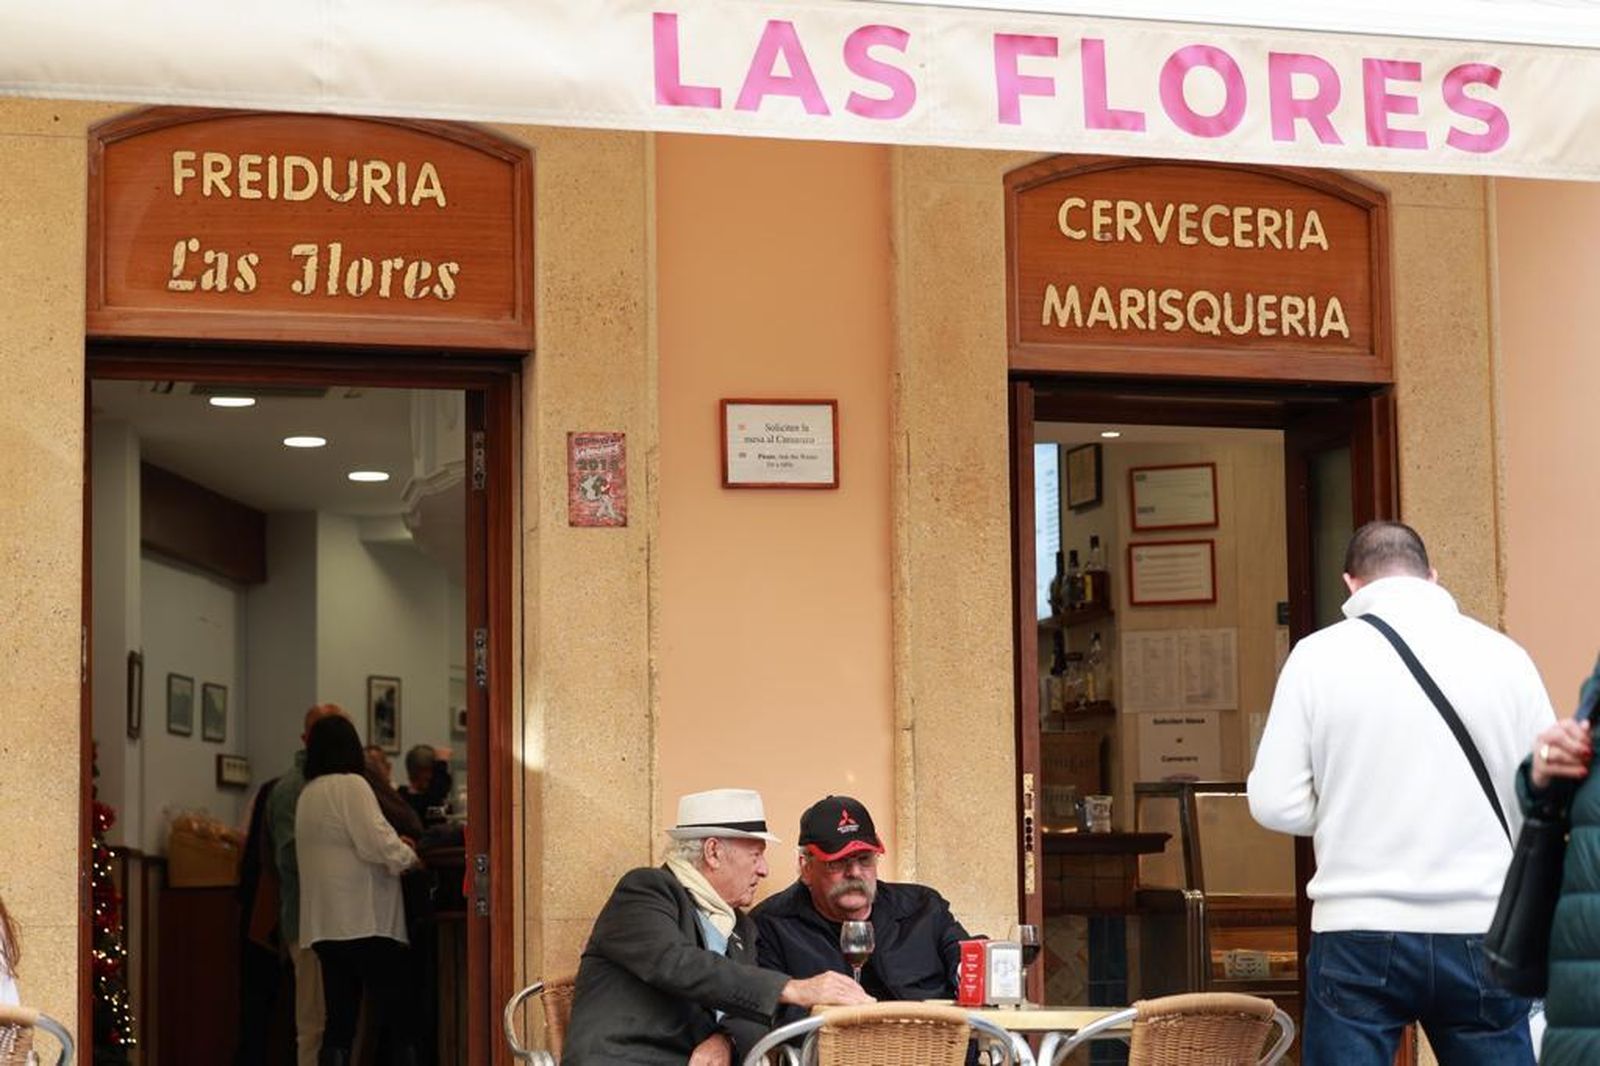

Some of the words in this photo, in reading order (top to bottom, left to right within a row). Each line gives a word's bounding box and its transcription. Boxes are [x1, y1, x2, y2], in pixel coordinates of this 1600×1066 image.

[653, 12, 916, 119] LAS
[994, 33, 1510, 152] FLORES
[172, 150, 447, 208] FREIDURIA
[1058, 197, 1329, 251] CERVECERIA
[167, 238, 260, 293] Las
[1042, 284, 1350, 338] MARISQUERIA
